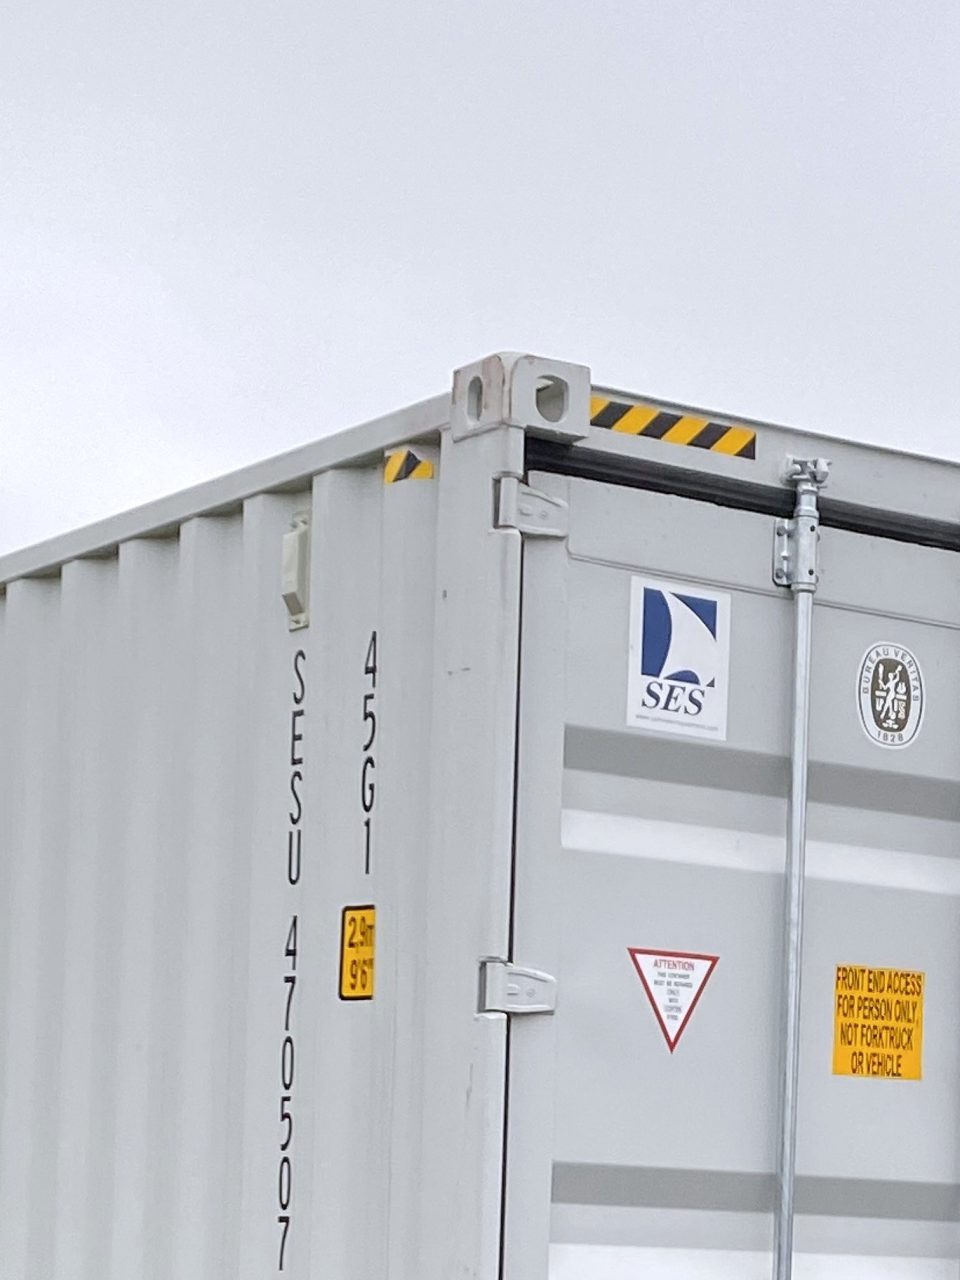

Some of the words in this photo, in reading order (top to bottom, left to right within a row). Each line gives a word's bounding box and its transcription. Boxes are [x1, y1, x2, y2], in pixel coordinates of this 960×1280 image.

[641, 680, 705, 716] SES
[288, 649, 306, 885] SESU
[361, 630, 377, 875] 45G1
[653, 958, 695, 971] ATTENTION
[836, 966, 866, 991] FRONT
[867, 969, 886, 993] END
[886, 970, 922, 997] ACCESS
[837, 994, 855, 1018] FOR
[856, 995, 893, 1021] PERSON
[840, 1022, 859, 1047] NOT
[860, 1024, 913, 1050] FORKTRUCK
[851, 1051, 864, 1074] OR
[866, 1052, 903, 1077] VEHICLE
[277, 915, 298, 1271] 470507
